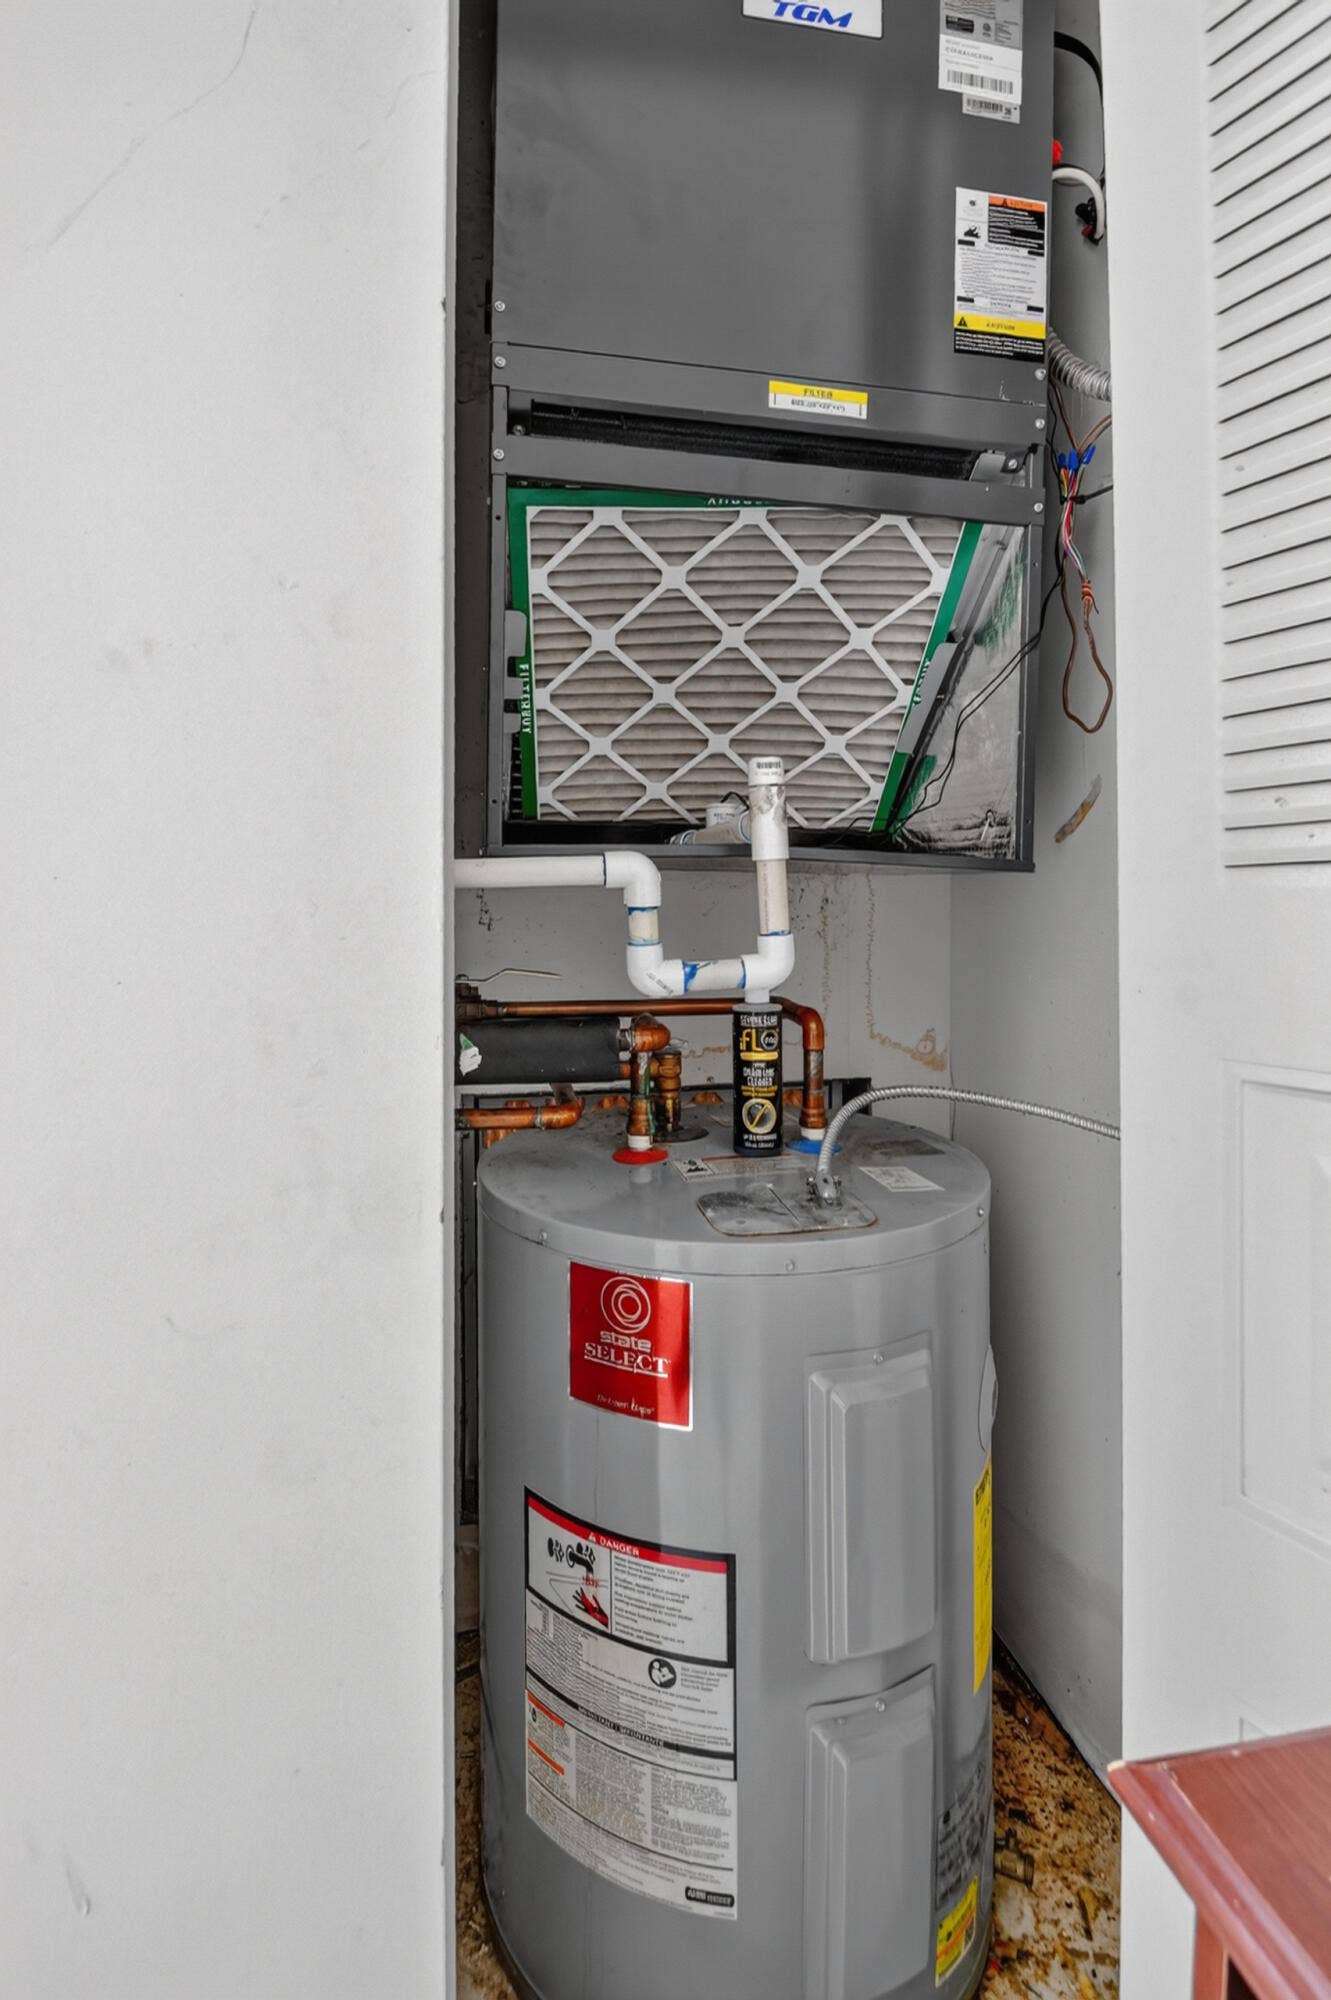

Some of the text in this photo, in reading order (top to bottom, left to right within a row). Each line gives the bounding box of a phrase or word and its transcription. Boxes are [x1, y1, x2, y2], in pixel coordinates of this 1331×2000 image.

[773, 0, 852, 28] TGM
[600, 1331, 651, 1353] state
[584, 1342, 669, 1373] SELECT
[599, 1536, 640, 1557] DANGER
